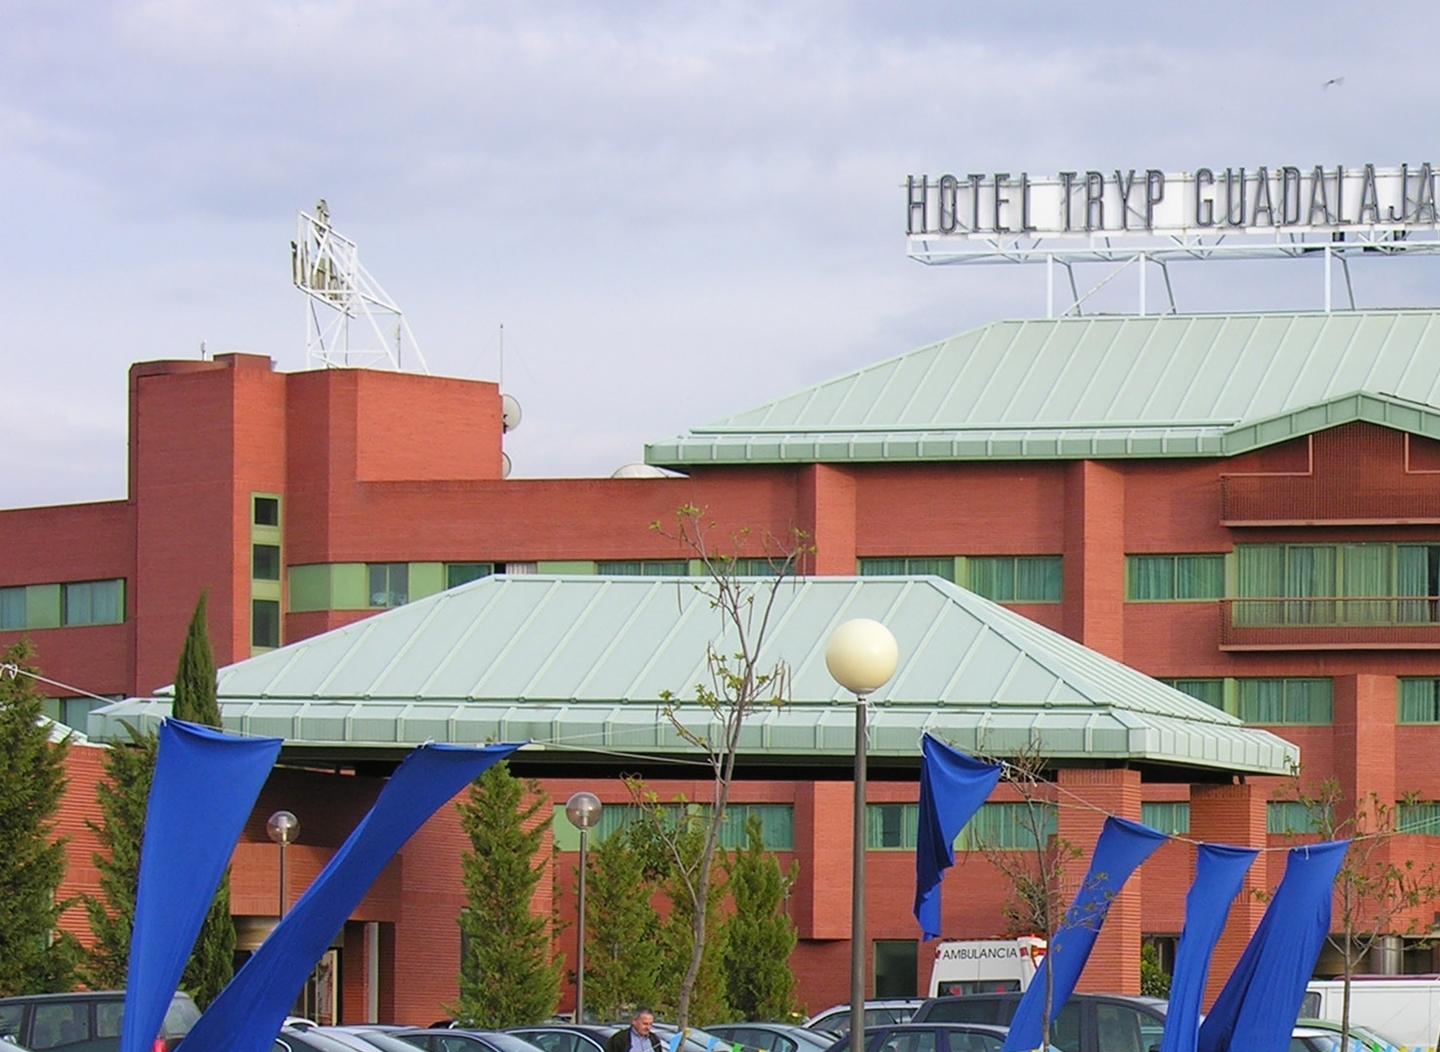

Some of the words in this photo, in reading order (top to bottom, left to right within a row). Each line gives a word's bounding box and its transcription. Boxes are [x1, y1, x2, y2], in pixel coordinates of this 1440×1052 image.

[905, 172, 1036, 234] HOTEL
[1058, 168, 1165, 232] TRYP
[943, 947, 1018, 960] AMBULANCIA
